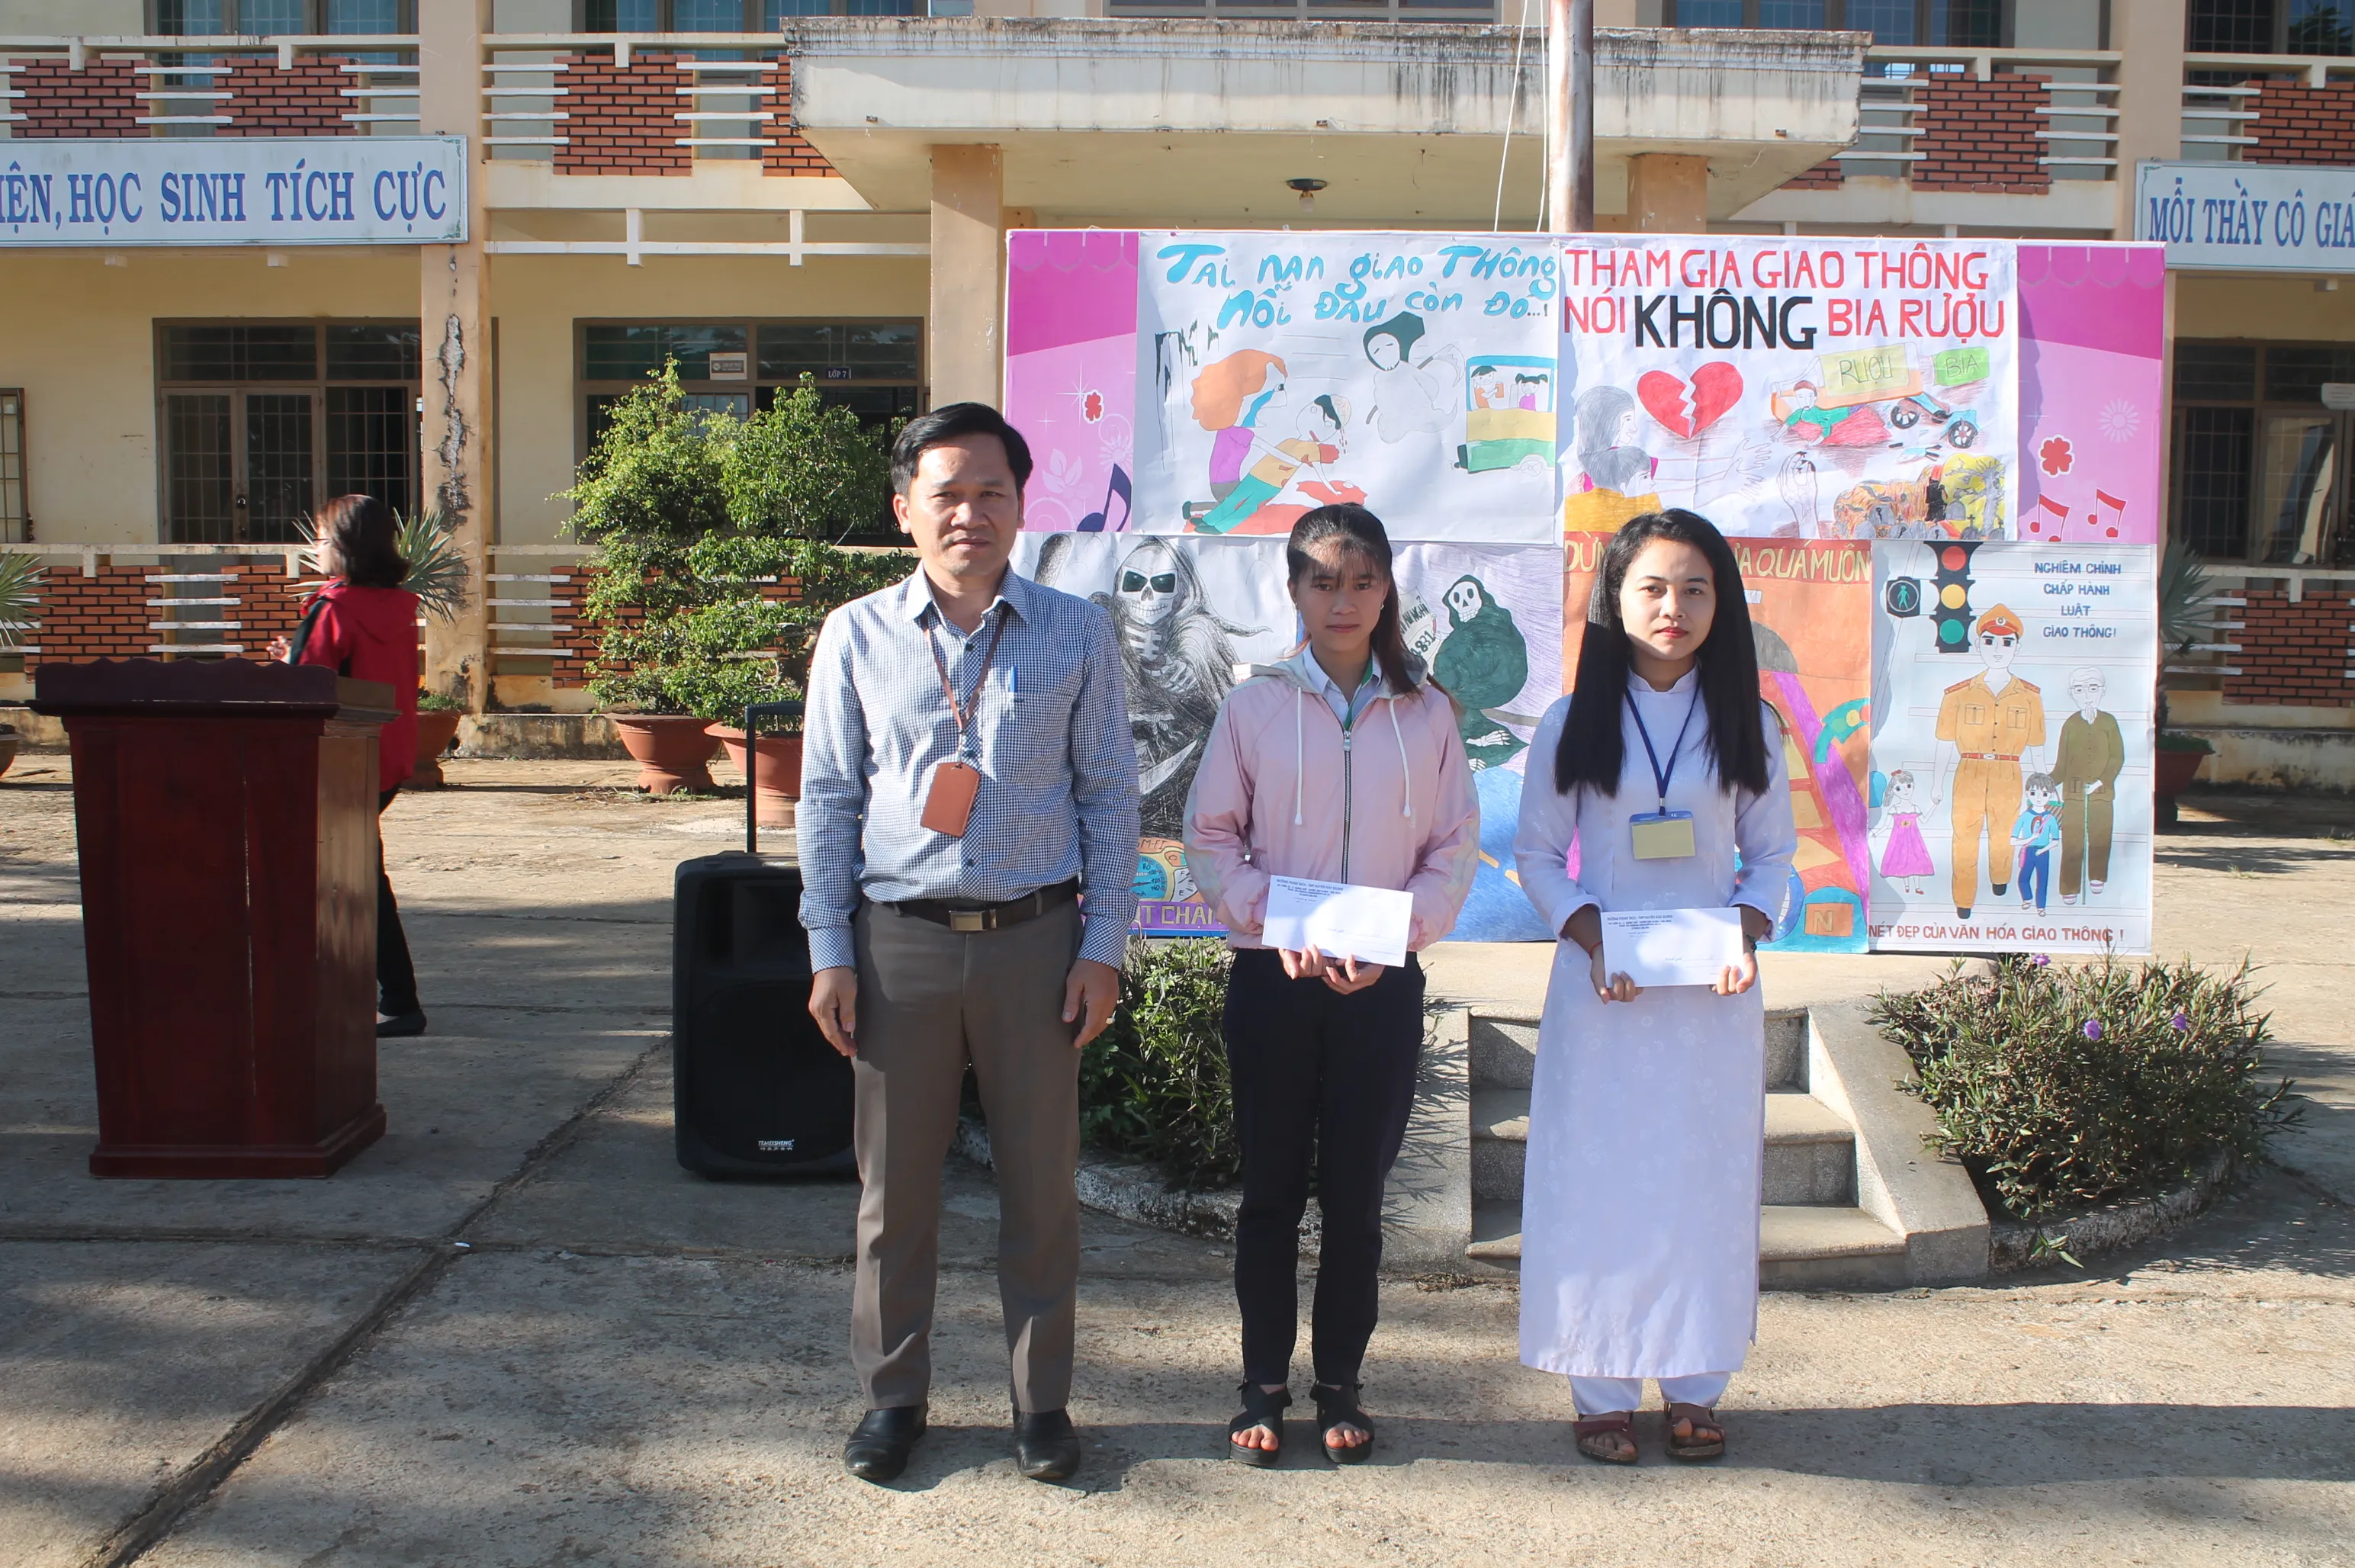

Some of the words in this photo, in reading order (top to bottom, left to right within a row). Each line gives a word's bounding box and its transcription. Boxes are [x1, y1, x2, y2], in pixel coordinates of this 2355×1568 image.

[160, 172, 246, 223] SINH
[265, 158, 355, 221] TÍCH
[374, 161, 446, 233] CỰC
[2202, 178, 2268, 245] THẦY
[2274, 188, 2305, 247] CÔ
[1565, 249, 1670, 287] THAM
[1680, 249, 1743, 288] GIA
[1753, 249, 1844, 289] GIAO
[1855, 243, 1989, 290] THÔNG
[1564, 287, 1625, 333] NÓI
[1634, 288, 1817, 350] KHÔNG
[1828, 298, 1888, 337] BIA
[1899, 292, 2004, 343] RƯỢU
[1756, 540, 1812, 579] QUÁ
[2034, 560, 2081, 574] NGHIÊM
[2086, 561, 2122, 574] CHỈNH
[2043, 579, 2074, 595] CHẤP
[2078, 581, 2110, 595] HÀNH
[2061, 602, 2091, 619] LUẬT
[2043, 625, 2069, 638] GIAO
[1868, 921, 1894, 938] NÉT
[1897, 925, 1920, 940] ĐẸP
[1923, 922, 1948, 939] CỦA
[1949, 924, 1979, 940] VĂN
[1986, 922, 2017, 940] HÓA
[2022, 925, 2057, 940] GIAO
